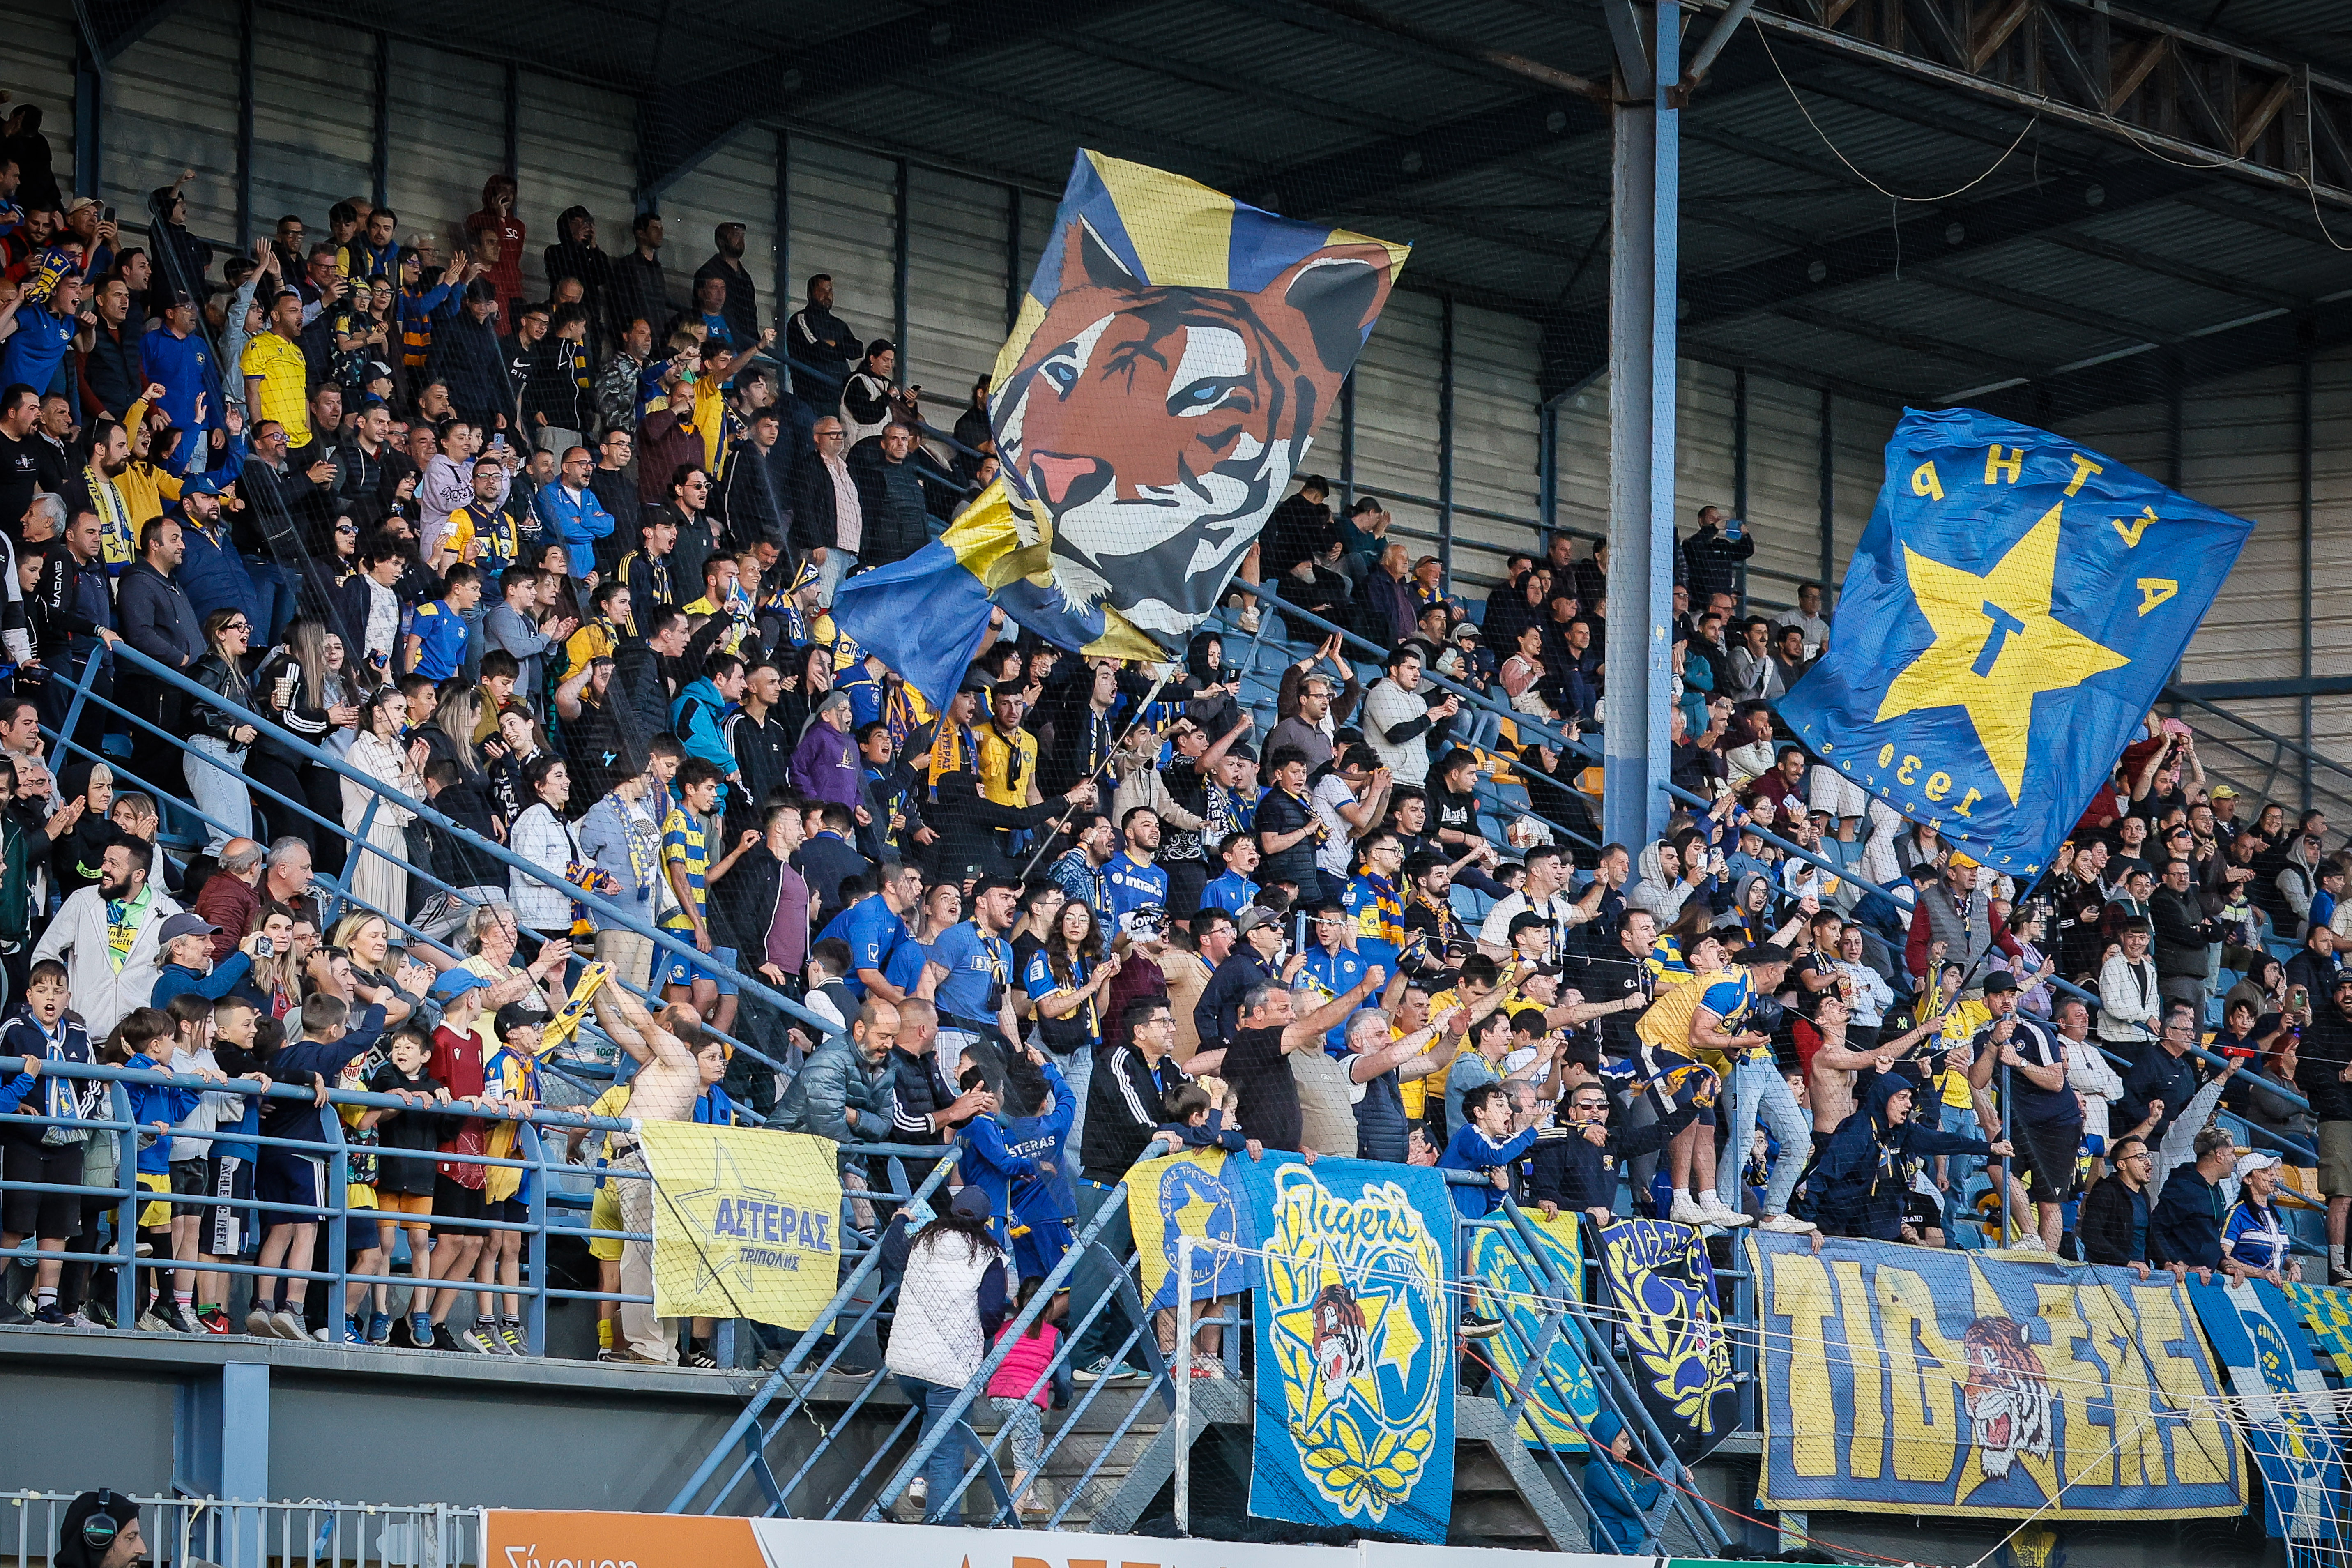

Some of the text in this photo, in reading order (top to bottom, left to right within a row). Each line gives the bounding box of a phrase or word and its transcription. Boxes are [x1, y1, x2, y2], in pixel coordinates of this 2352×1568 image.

[510, 368, 527, 380] AIR
[54, 560, 63, 609] GIVOVA
[109, 937, 135, 946] wette
[1008, 1135, 1055, 1158] STERAS
[218, 1163, 231, 1214] ATHLEC
[714, 1198, 832, 1252] ΑΣΤΕΡΑΣ
[1901, 1215, 1923, 1223] SLAND
[740, 1248, 801, 1272] ΤΡΙΠΟΛΗΣ
